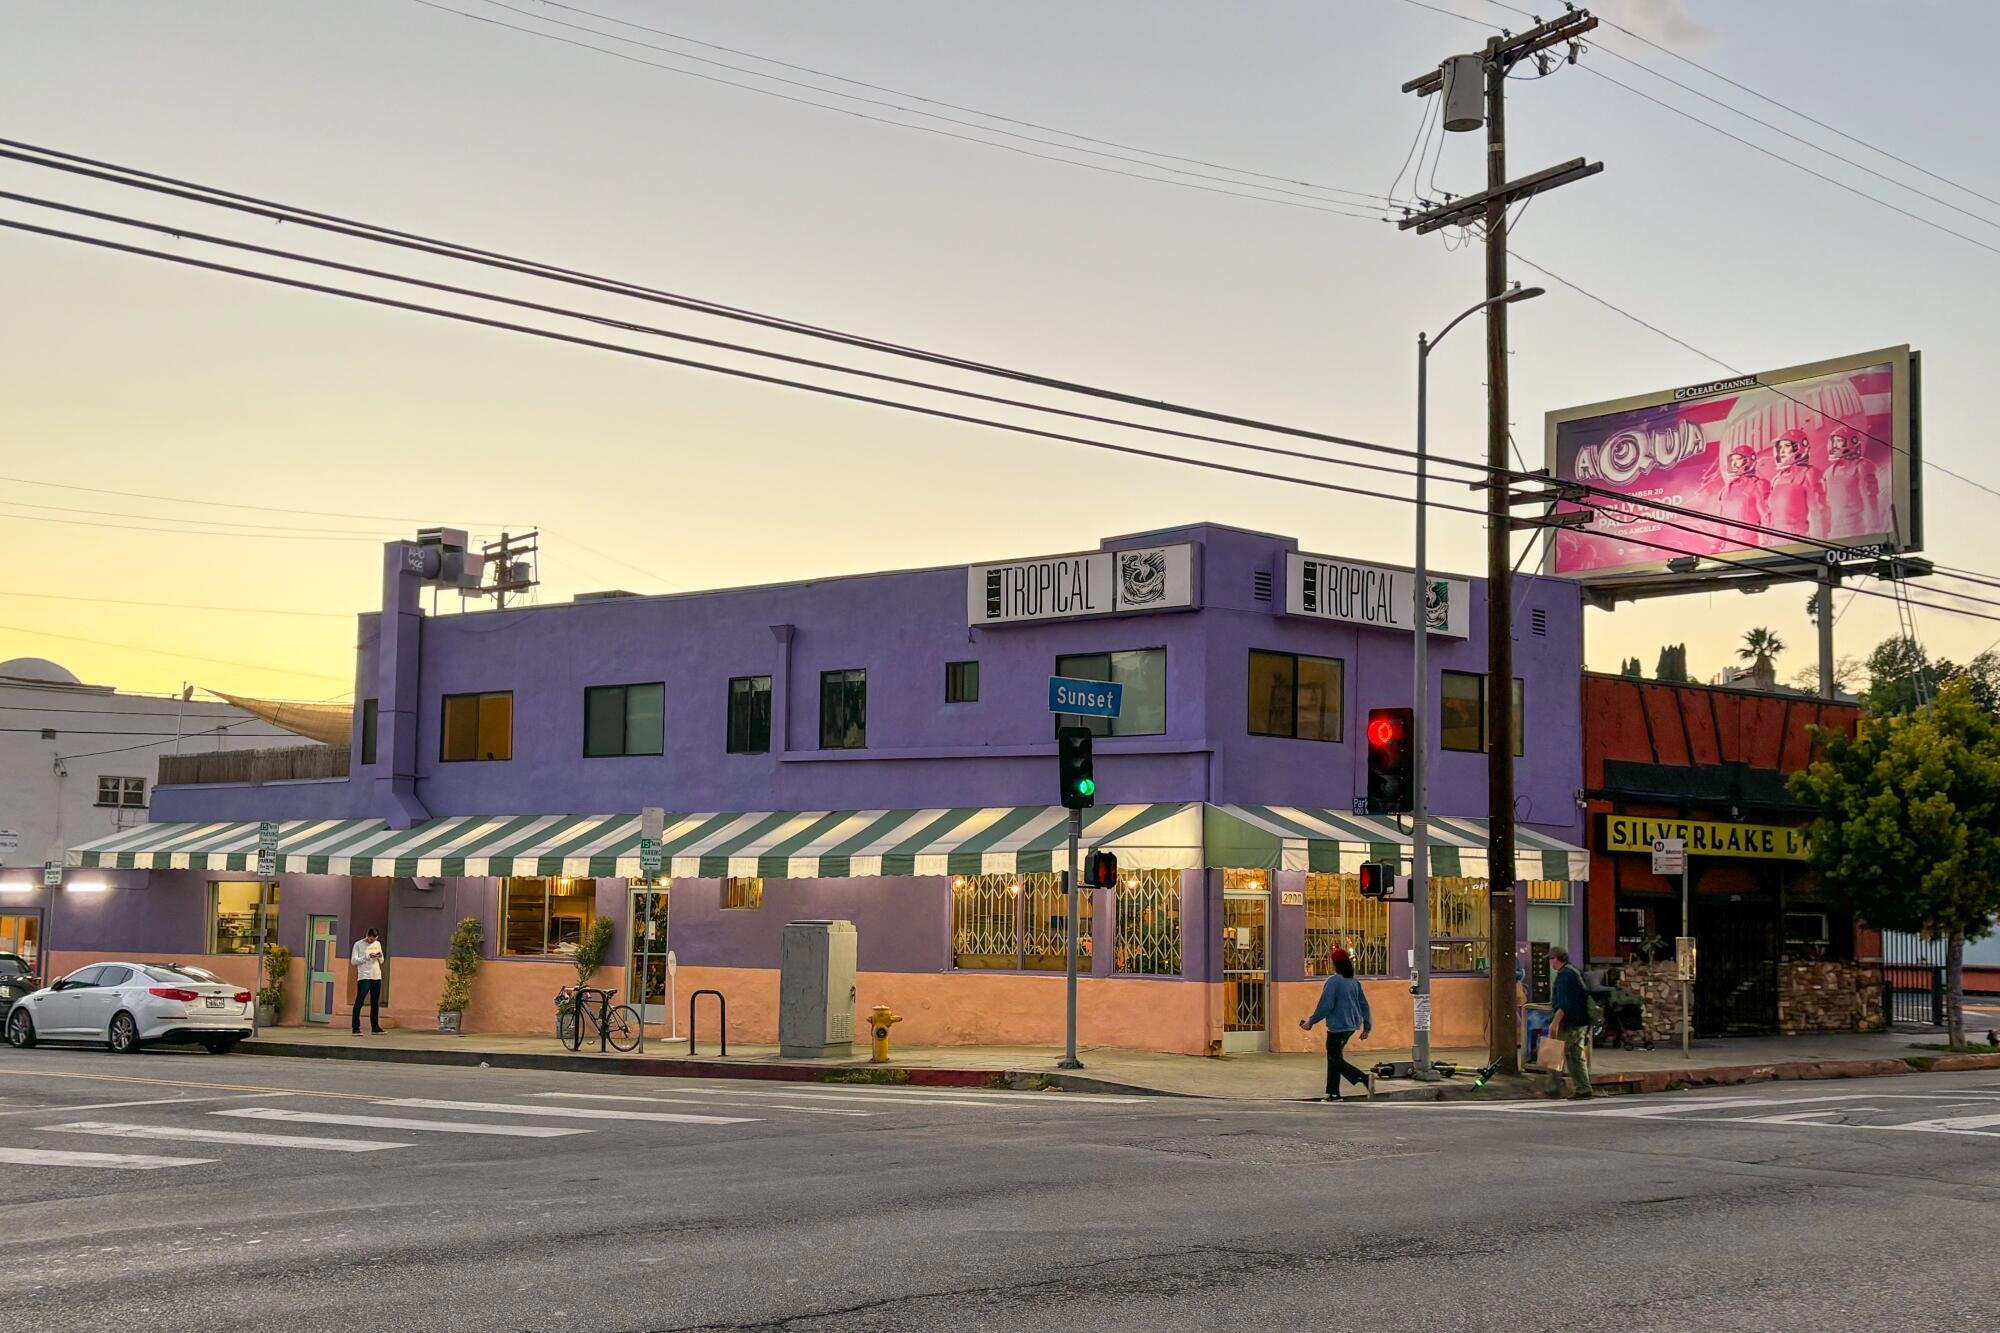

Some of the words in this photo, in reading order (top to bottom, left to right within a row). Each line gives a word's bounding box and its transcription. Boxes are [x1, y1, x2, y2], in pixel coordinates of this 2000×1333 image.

[1574, 418, 1707, 487] AQUA
[1002, 559, 1095, 617] TROPICAL
[1317, 563, 1398, 624] TROPICAL
[1057, 686, 1114, 709] Sunset
[641, 840, 650, 848] 15
[1612, 820, 1774, 853] SILVERLAKE
